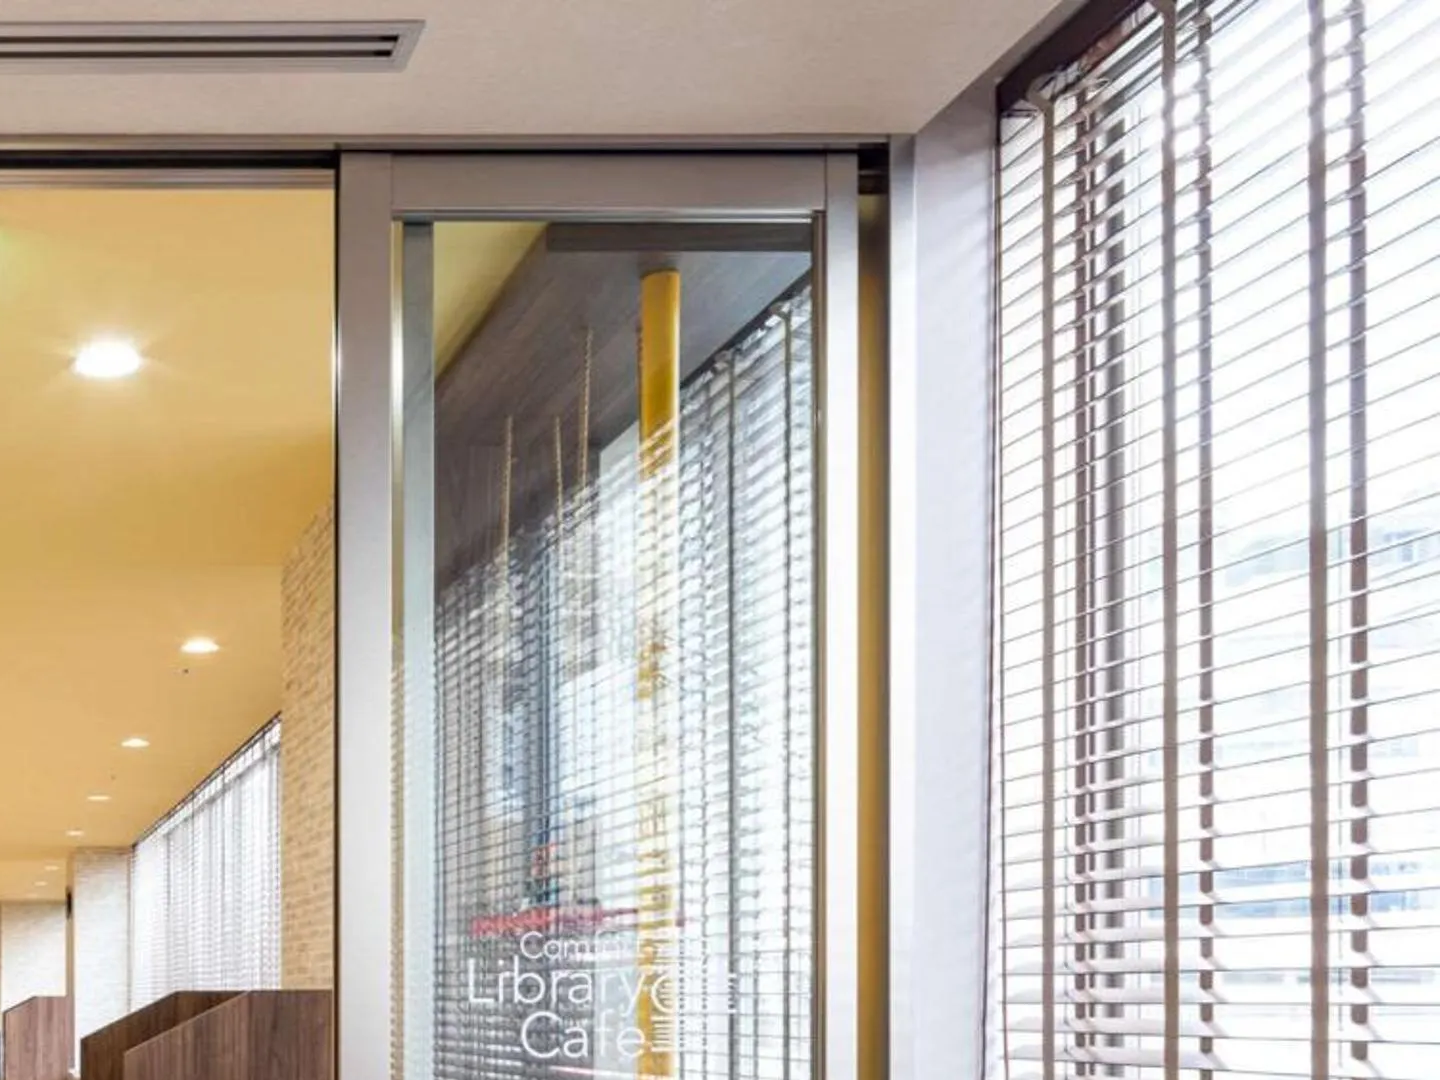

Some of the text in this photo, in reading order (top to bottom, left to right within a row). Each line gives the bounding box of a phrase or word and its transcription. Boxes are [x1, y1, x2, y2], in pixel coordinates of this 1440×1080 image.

[519, 930, 646, 960] Comft
[469, 955, 645, 1017] Library
[521, 1010, 645, 1059] Cafe
